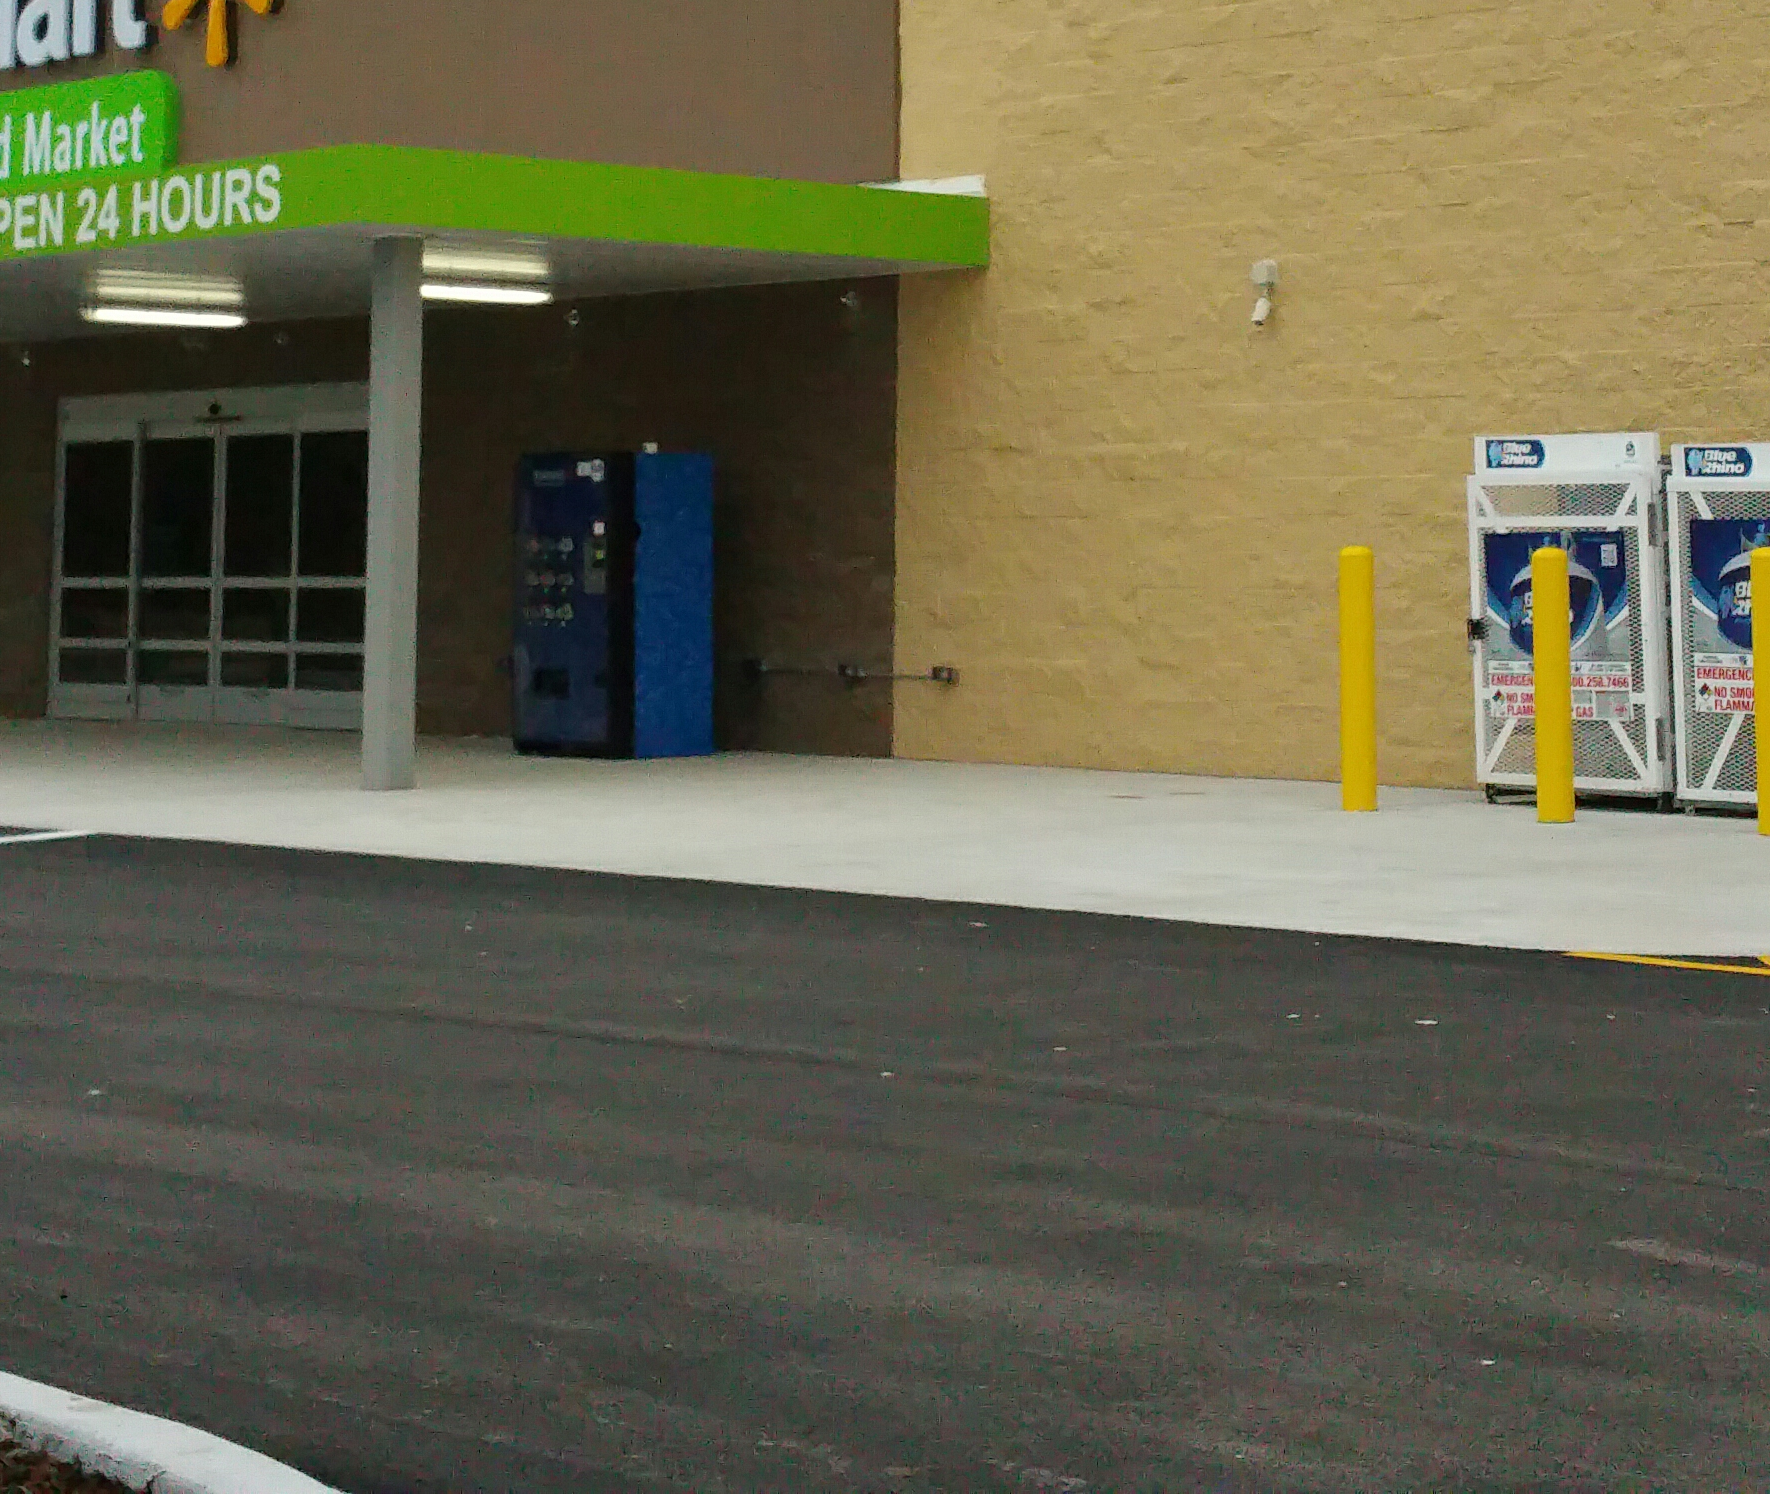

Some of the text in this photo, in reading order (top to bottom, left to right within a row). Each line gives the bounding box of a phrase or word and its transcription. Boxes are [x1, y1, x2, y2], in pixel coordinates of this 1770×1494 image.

[22, 101, 147, 177] Market
[75, 184, 121, 244] 24
[131, 163, 282, 238] HOURS
[1696, 667, 1754, 681] EMERGENC
[1714, 686, 1728, 698] NO
